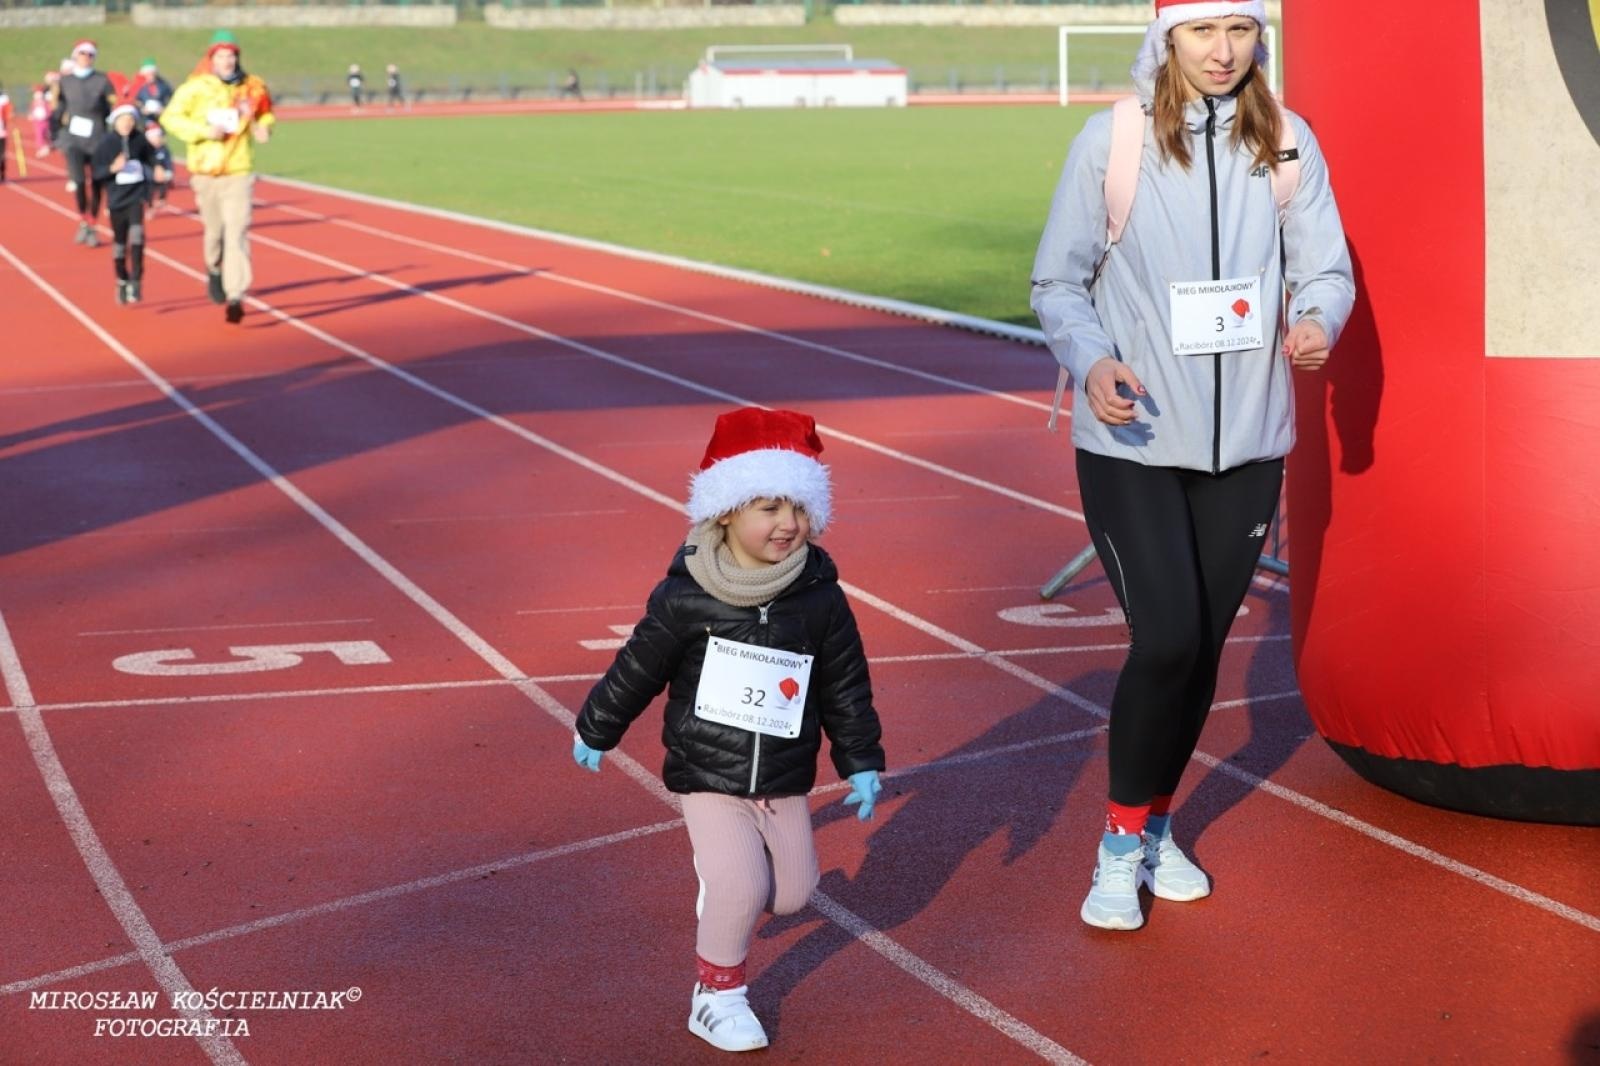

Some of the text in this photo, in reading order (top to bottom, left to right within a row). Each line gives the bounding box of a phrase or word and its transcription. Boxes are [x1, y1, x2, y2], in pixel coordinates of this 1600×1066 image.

[1250, 165, 1270, 178] 4F
[1177, 281, 1254, 296] BIEG MIKOŁAJKOWY
[1215, 316, 1225, 332] 3
[1179, 340, 1214, 351] Racibórz
[112, 640, 392, 677] 5
[716, 644, 804, 669] BIEG MIKOŁAJKOWY
[740, 686, 766, 708] 32
[703, 703, 741, 720] Racibórz
